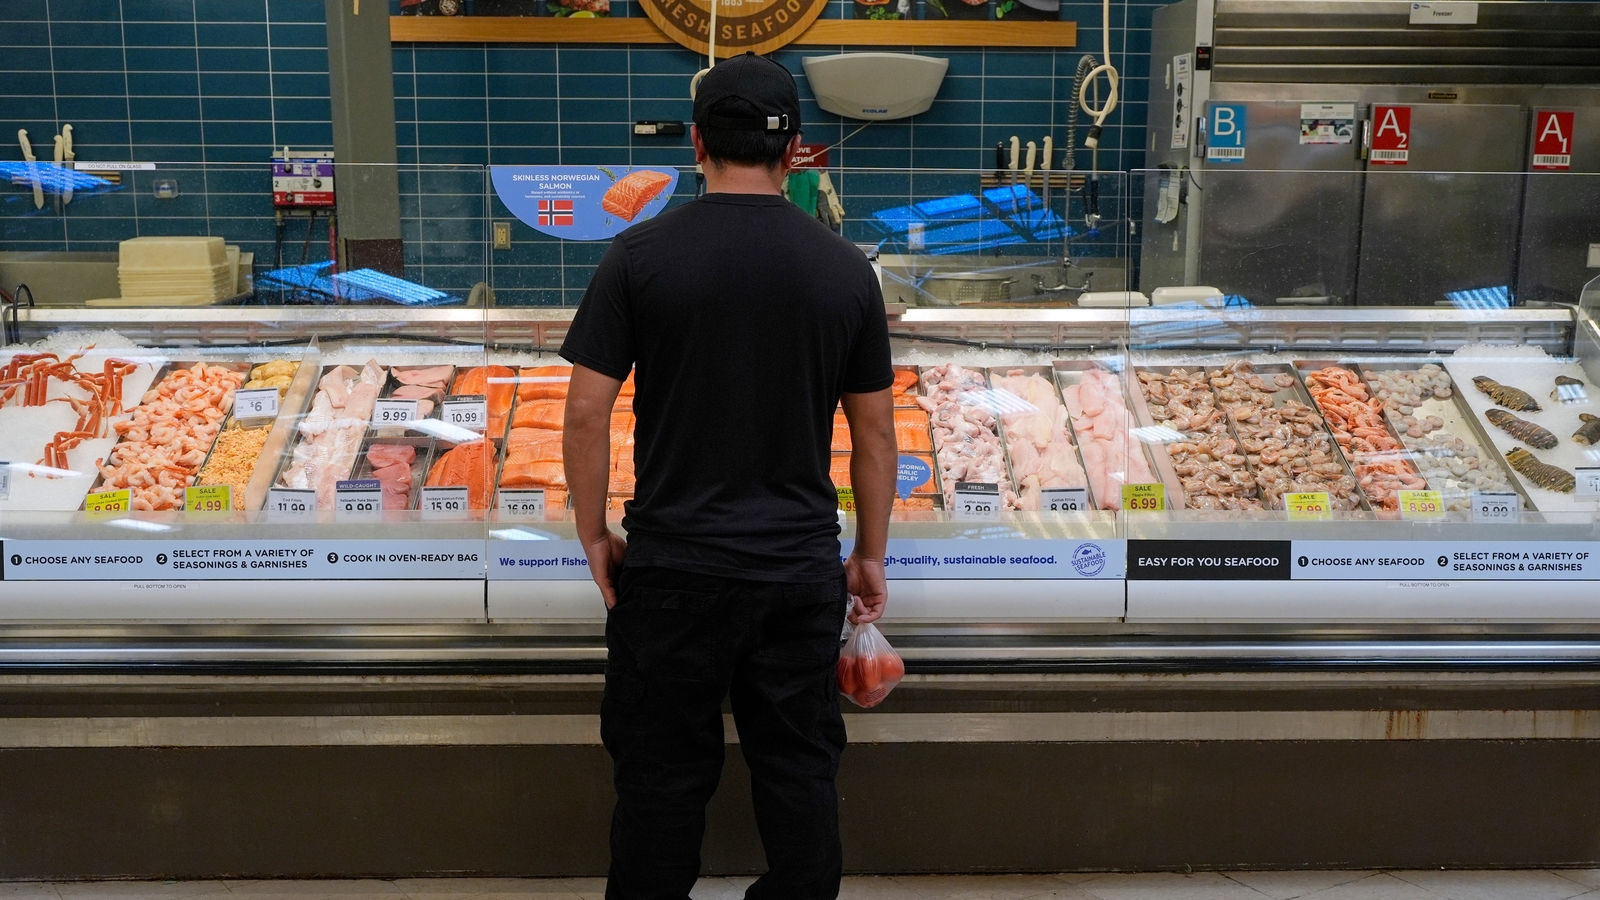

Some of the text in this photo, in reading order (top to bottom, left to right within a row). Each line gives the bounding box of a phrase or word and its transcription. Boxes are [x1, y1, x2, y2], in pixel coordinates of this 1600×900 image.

[661, 0, 800, 40] RESH SEAFOO
[250, 401, 262, 411] $6
[383, 411, 407, 421] 9.99
[452, 413, 476, 422] 10.99
[195, 500, 222, 511] 4.99
[1130, 498, 1157, 509] 6.99
[1410, 503, 1435, 512] 8.99
[173, 550, 210, 558] SELECT
[343, 554, 373, 562] COOK
[389, 554, 455, 562] OVEN-READY
[1071, 552, 1106, 566] SUSTAINABLE
[25, 556, 68, 565] CHOOSE
[70, 556, 92, 564] ANY
[94, 556, 143, 564] SEAFOOD
[173, 561, 238, 569] SEASONINGS
[499, 557, 590, 567] We support Fishe
[884, 556, 940, 566] gh-quality,
[943, 556, 1006, 565] sustainable
[1010, 556, 1057, 565] seafood.
[1077, 559, 1103, 570] SEAFOOD
[1138, 557, 1279, 566] EASY FOR YOU SEAFOOD
